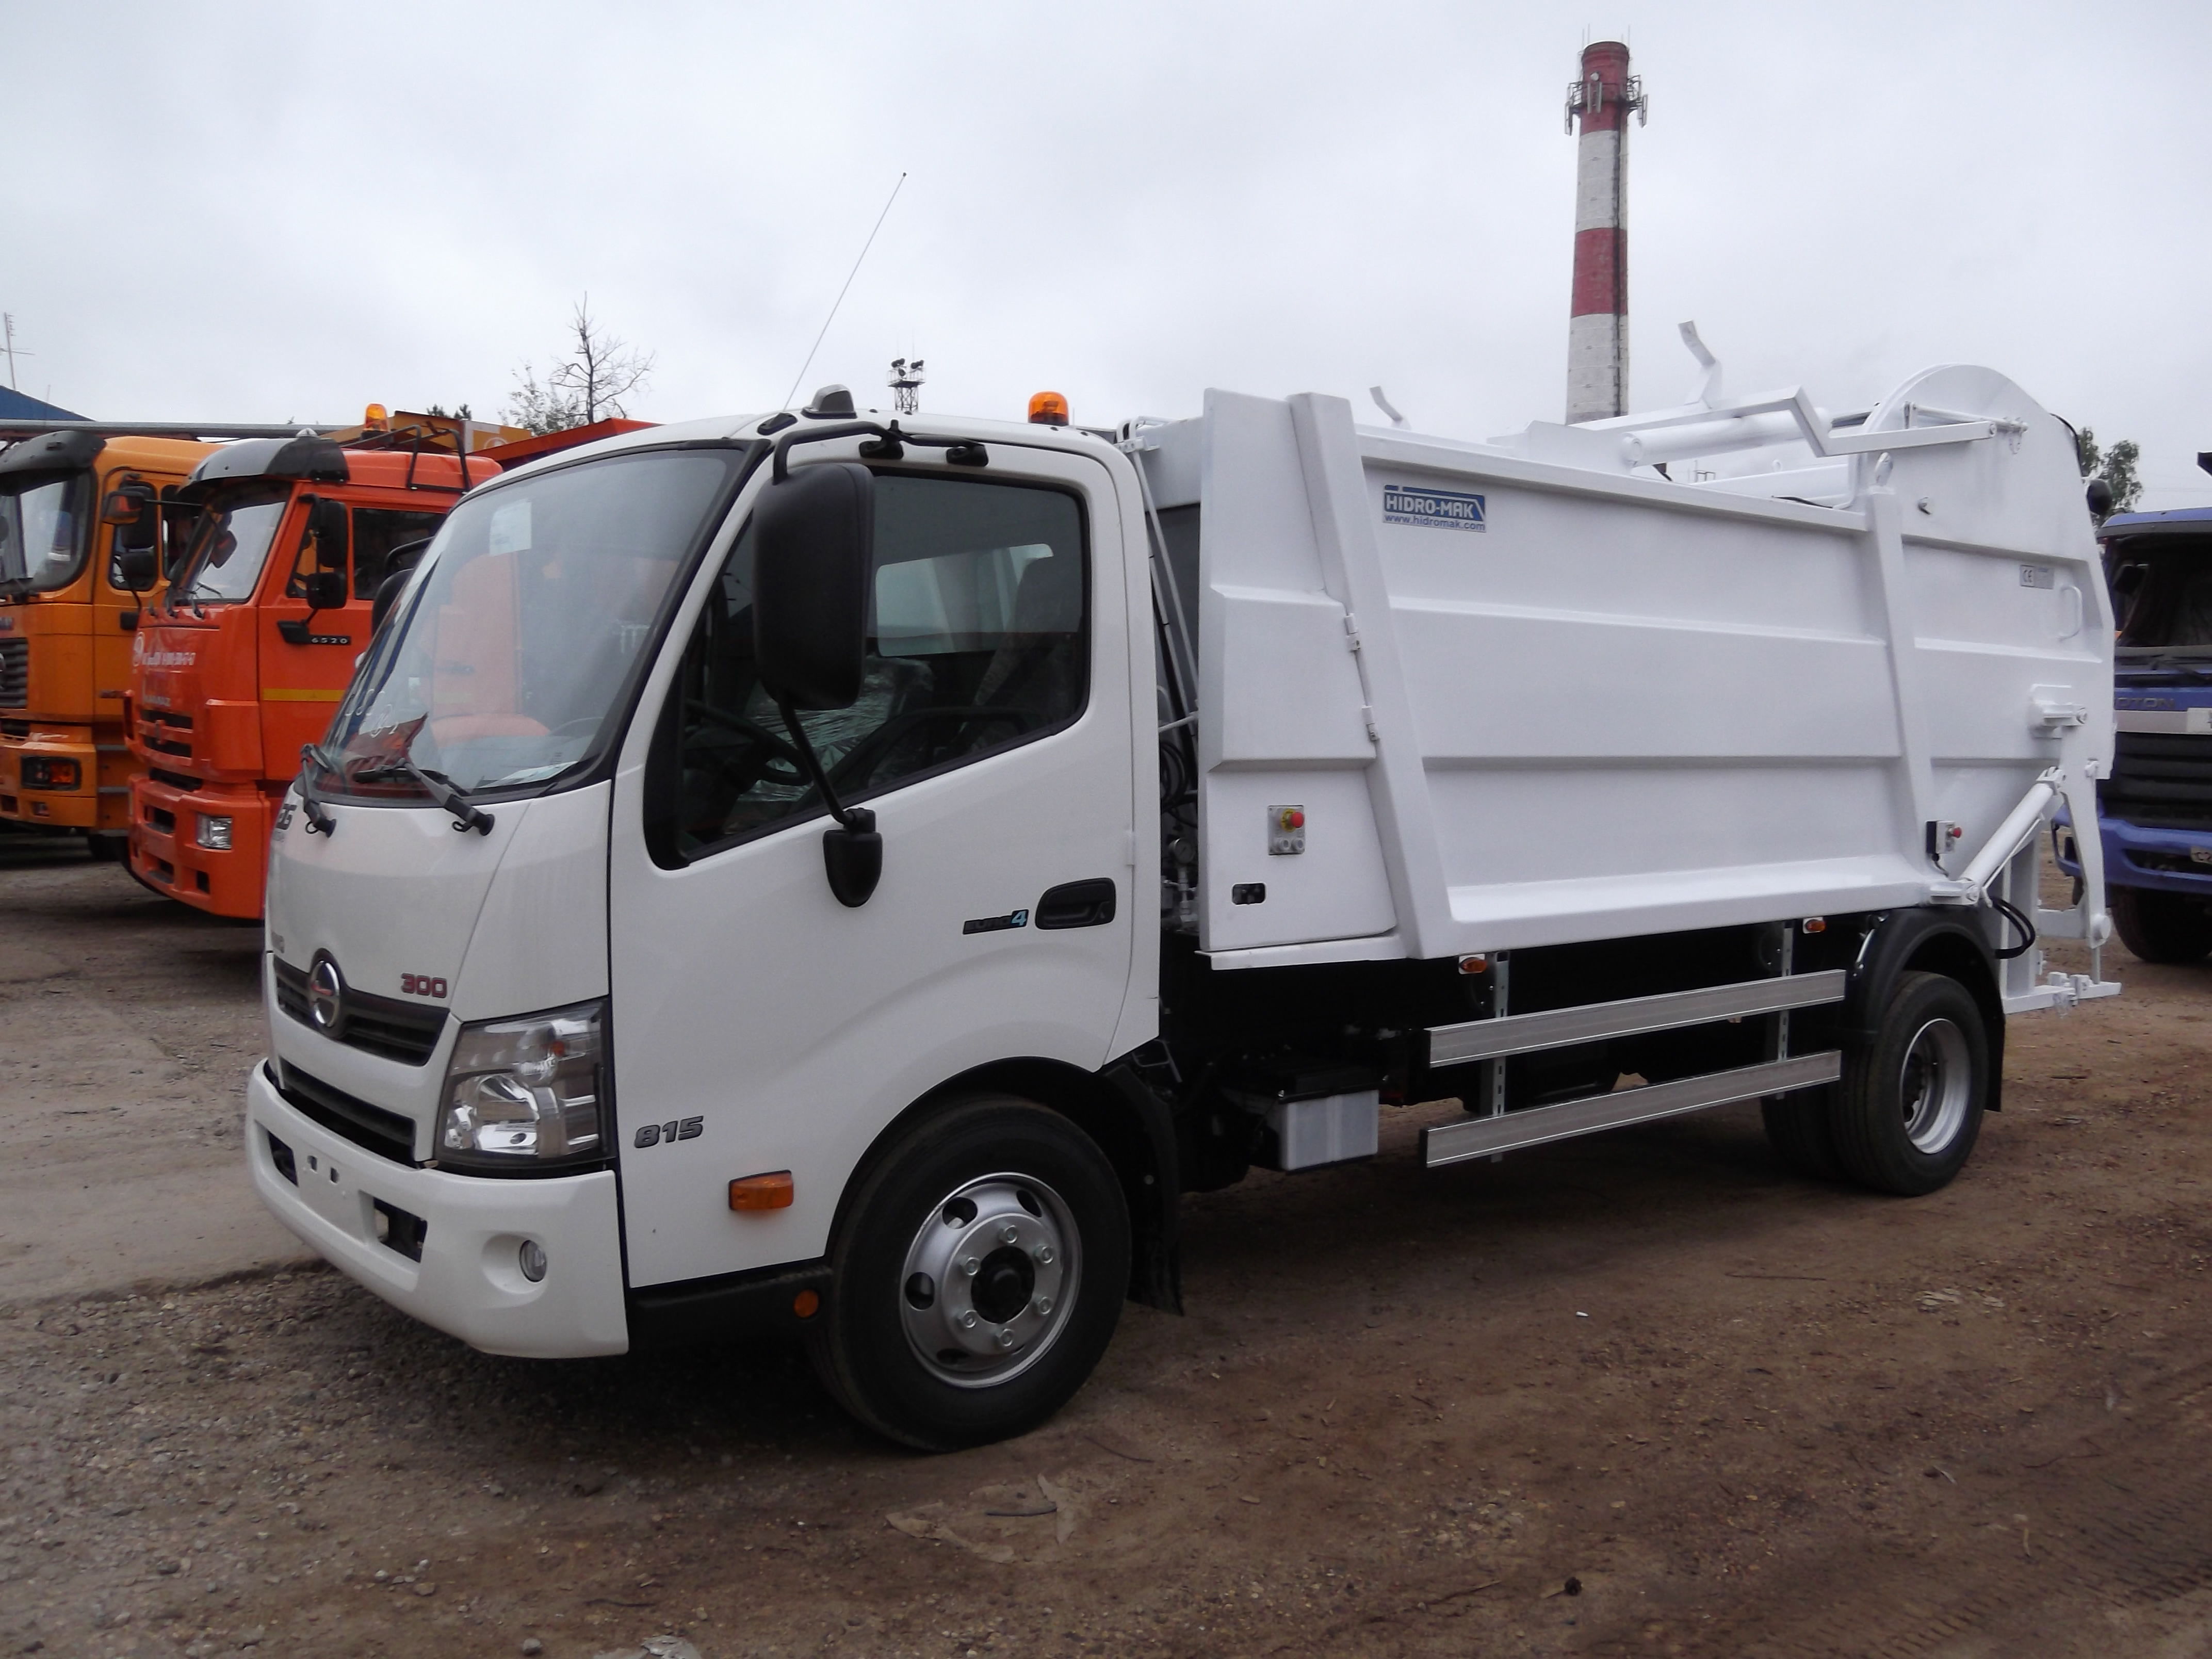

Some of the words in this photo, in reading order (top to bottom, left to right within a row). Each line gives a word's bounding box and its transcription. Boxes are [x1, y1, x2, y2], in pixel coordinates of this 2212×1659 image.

[1386, 495, 1474, 518] HIDRO-MAK
[1385, 515, 1485, 531] www.hidromak.com
[1011, 910, 1027, 926] 4
[401, 973, 447, 998] 300
[634, 1115, 704, 1149] 815
